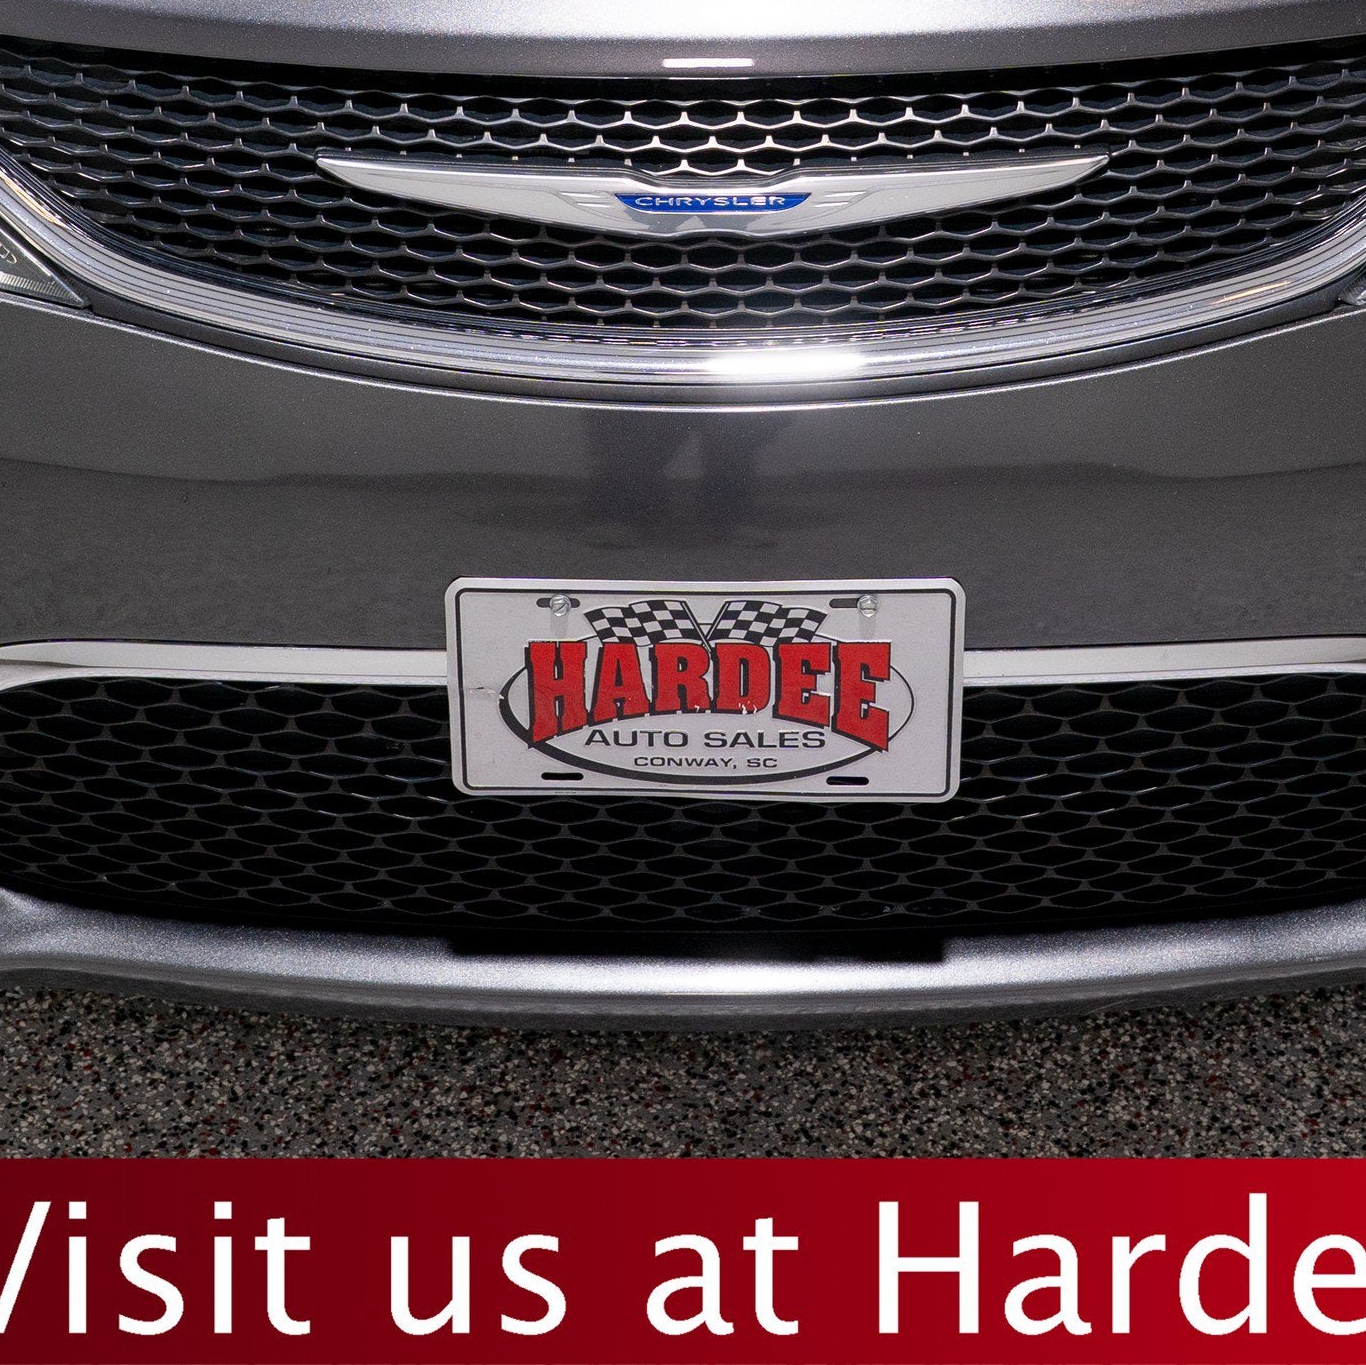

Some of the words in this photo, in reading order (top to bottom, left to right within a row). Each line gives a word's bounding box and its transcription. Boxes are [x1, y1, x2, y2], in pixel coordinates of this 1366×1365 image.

[634, 196, 786, 206] CHRYSLER
[526, 640, 892, 752] HARDEE
[584, 728, 690, 749] AUTO
[704, 730, 826, 749] SALES
[633, 754, 737, 769] CONWAY,
[746, 756, 778, 769] SC
